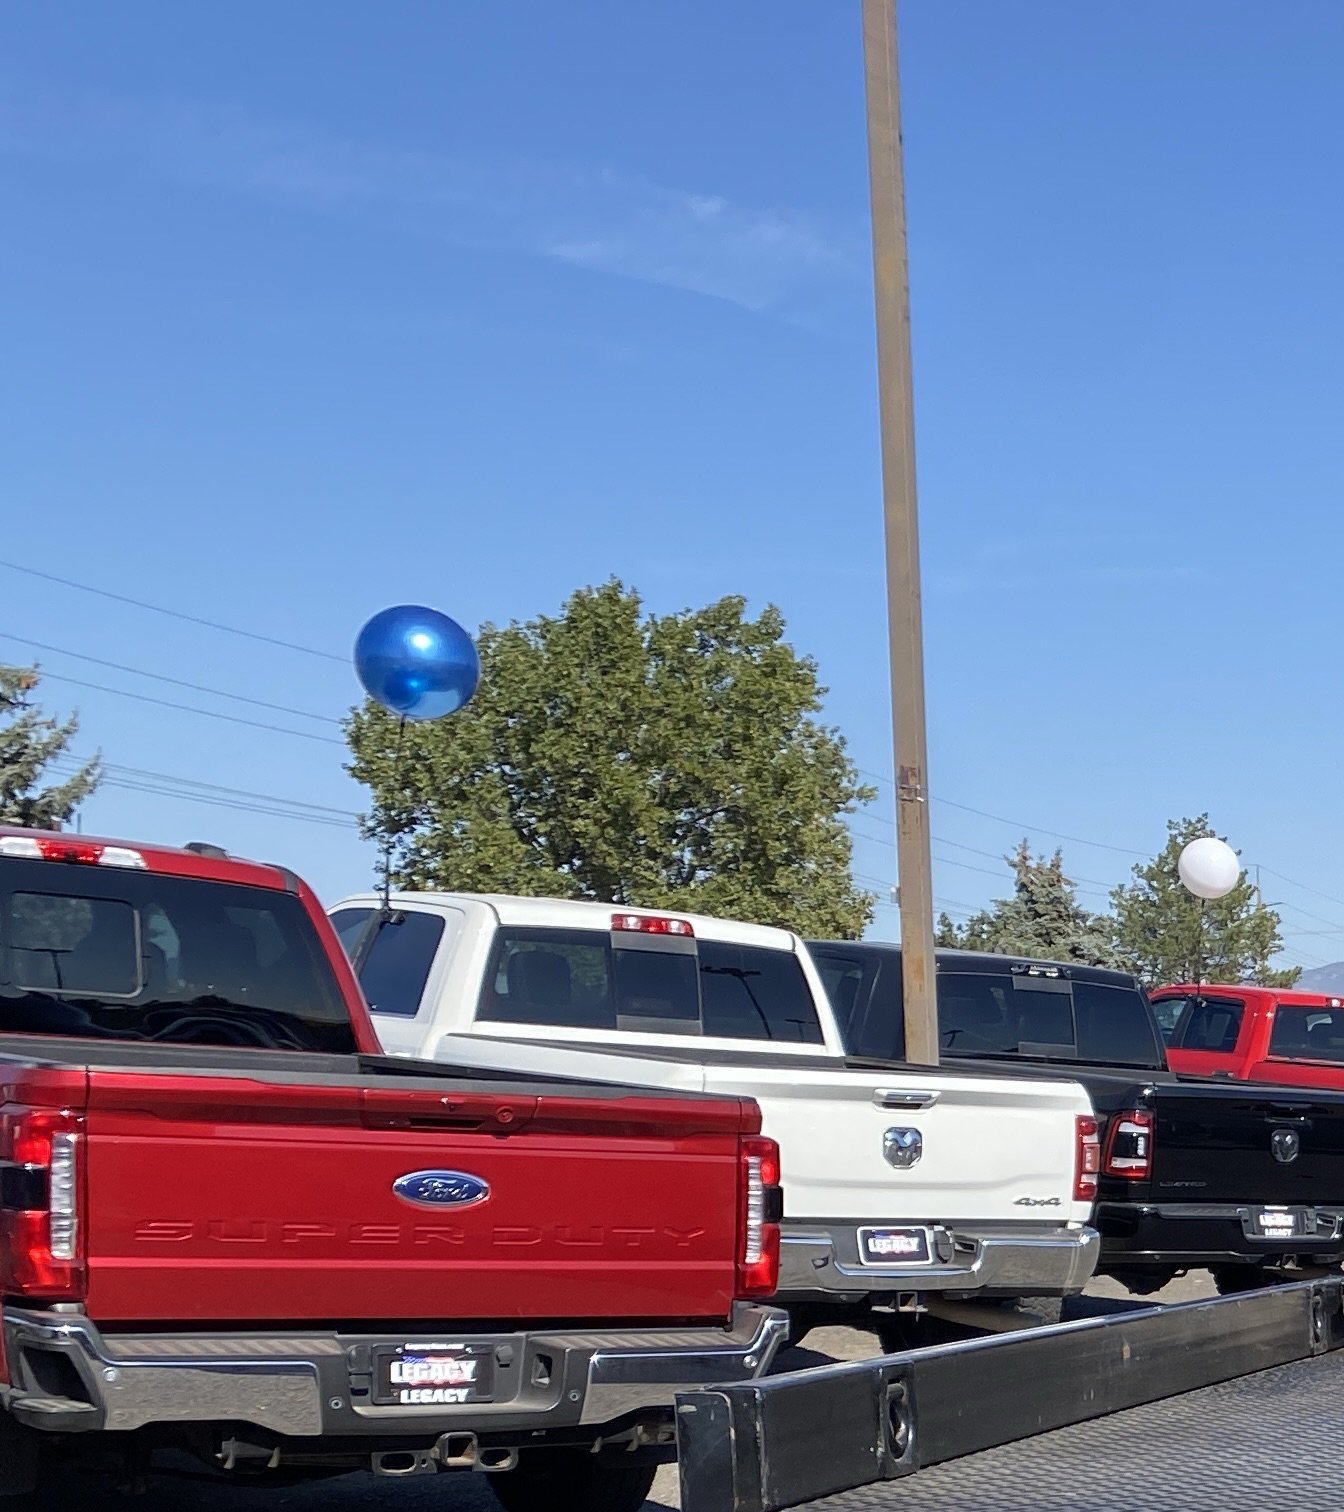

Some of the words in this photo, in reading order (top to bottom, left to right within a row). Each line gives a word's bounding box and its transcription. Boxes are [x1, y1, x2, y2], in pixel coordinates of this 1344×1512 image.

[418, 1178, 469, 1199] Ford
[135, 1219, 465, 1245] SUPER
[492, 1224, 705, 1247] DUTY
[867, 1237, 920, 1252] LEGACY
[390, 1361, 477, 1381] LEGACY
[400, 1388, 469, 1403] LEGACY
